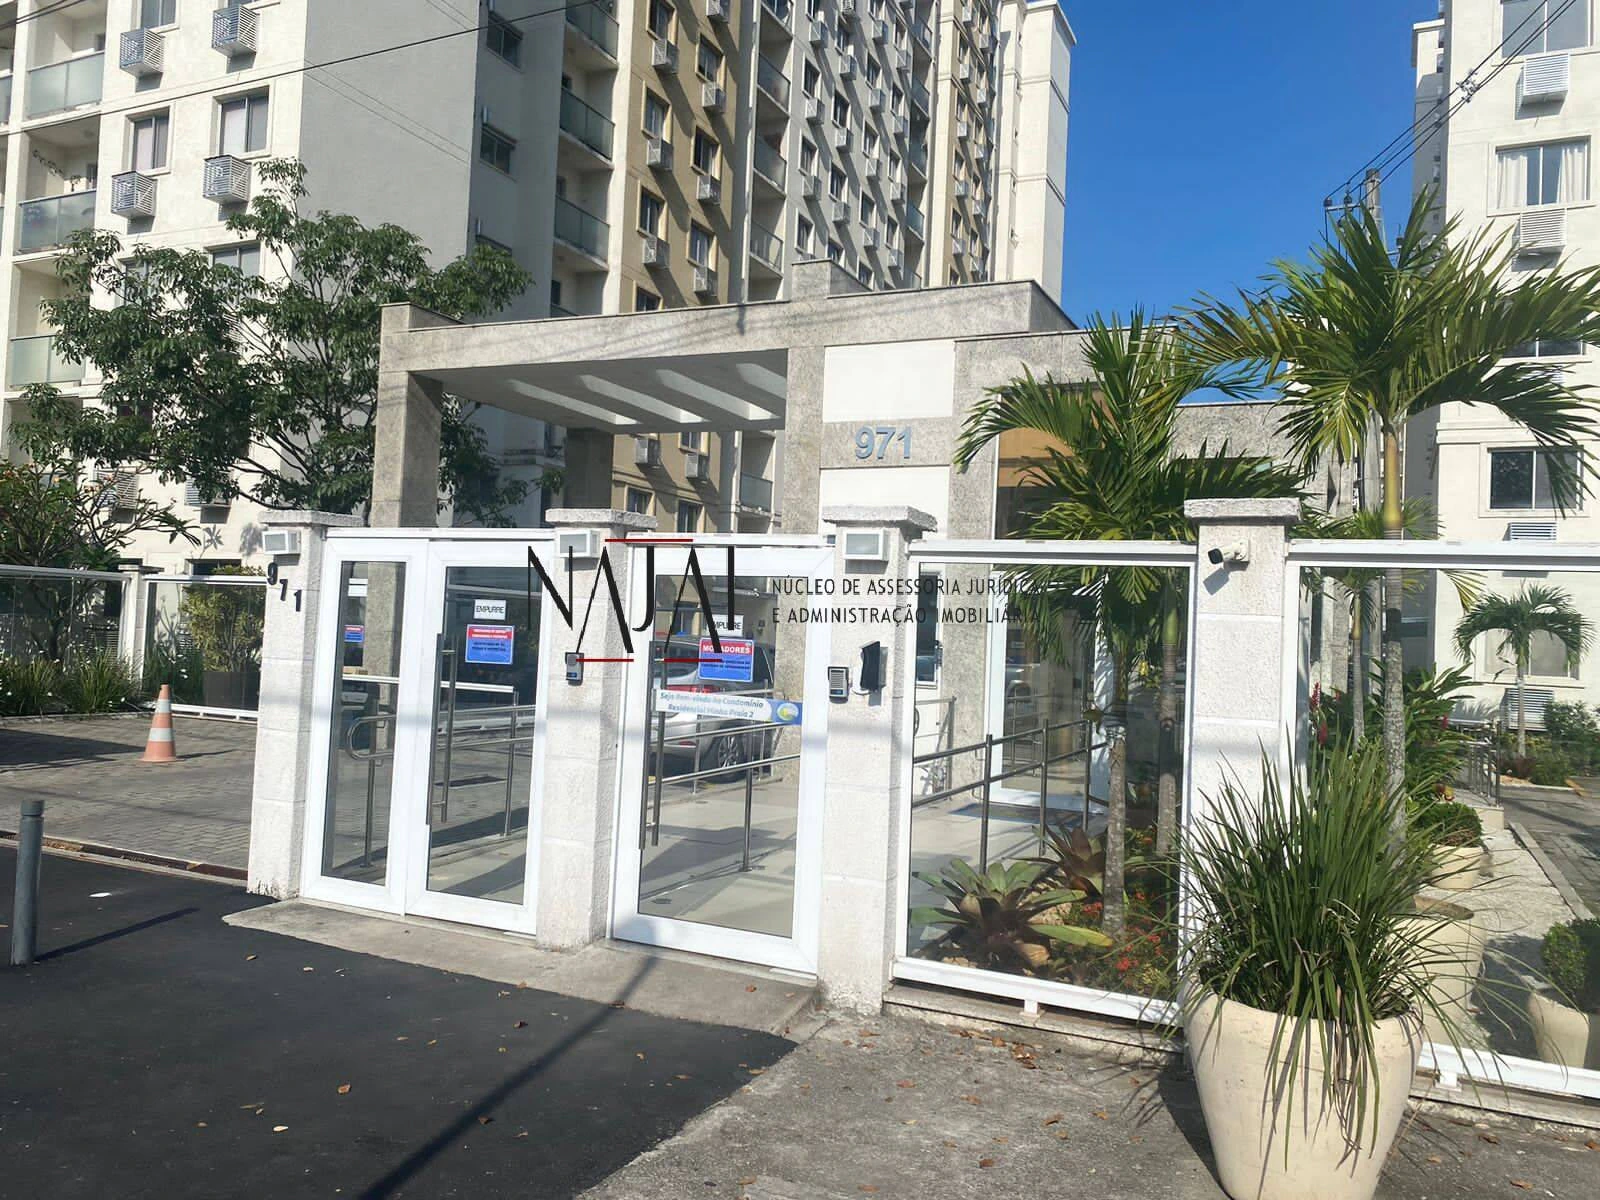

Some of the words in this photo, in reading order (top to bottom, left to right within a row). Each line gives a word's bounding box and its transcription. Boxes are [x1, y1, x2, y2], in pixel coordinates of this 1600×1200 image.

[855, 426, 912, 460] 971
[267, 562, 302, 612] 971
[475, 605, 505, 614] EMPURRE
[702, 644, 751, 654] MOADORES
[723, 699, 764, 709] Condomínio
